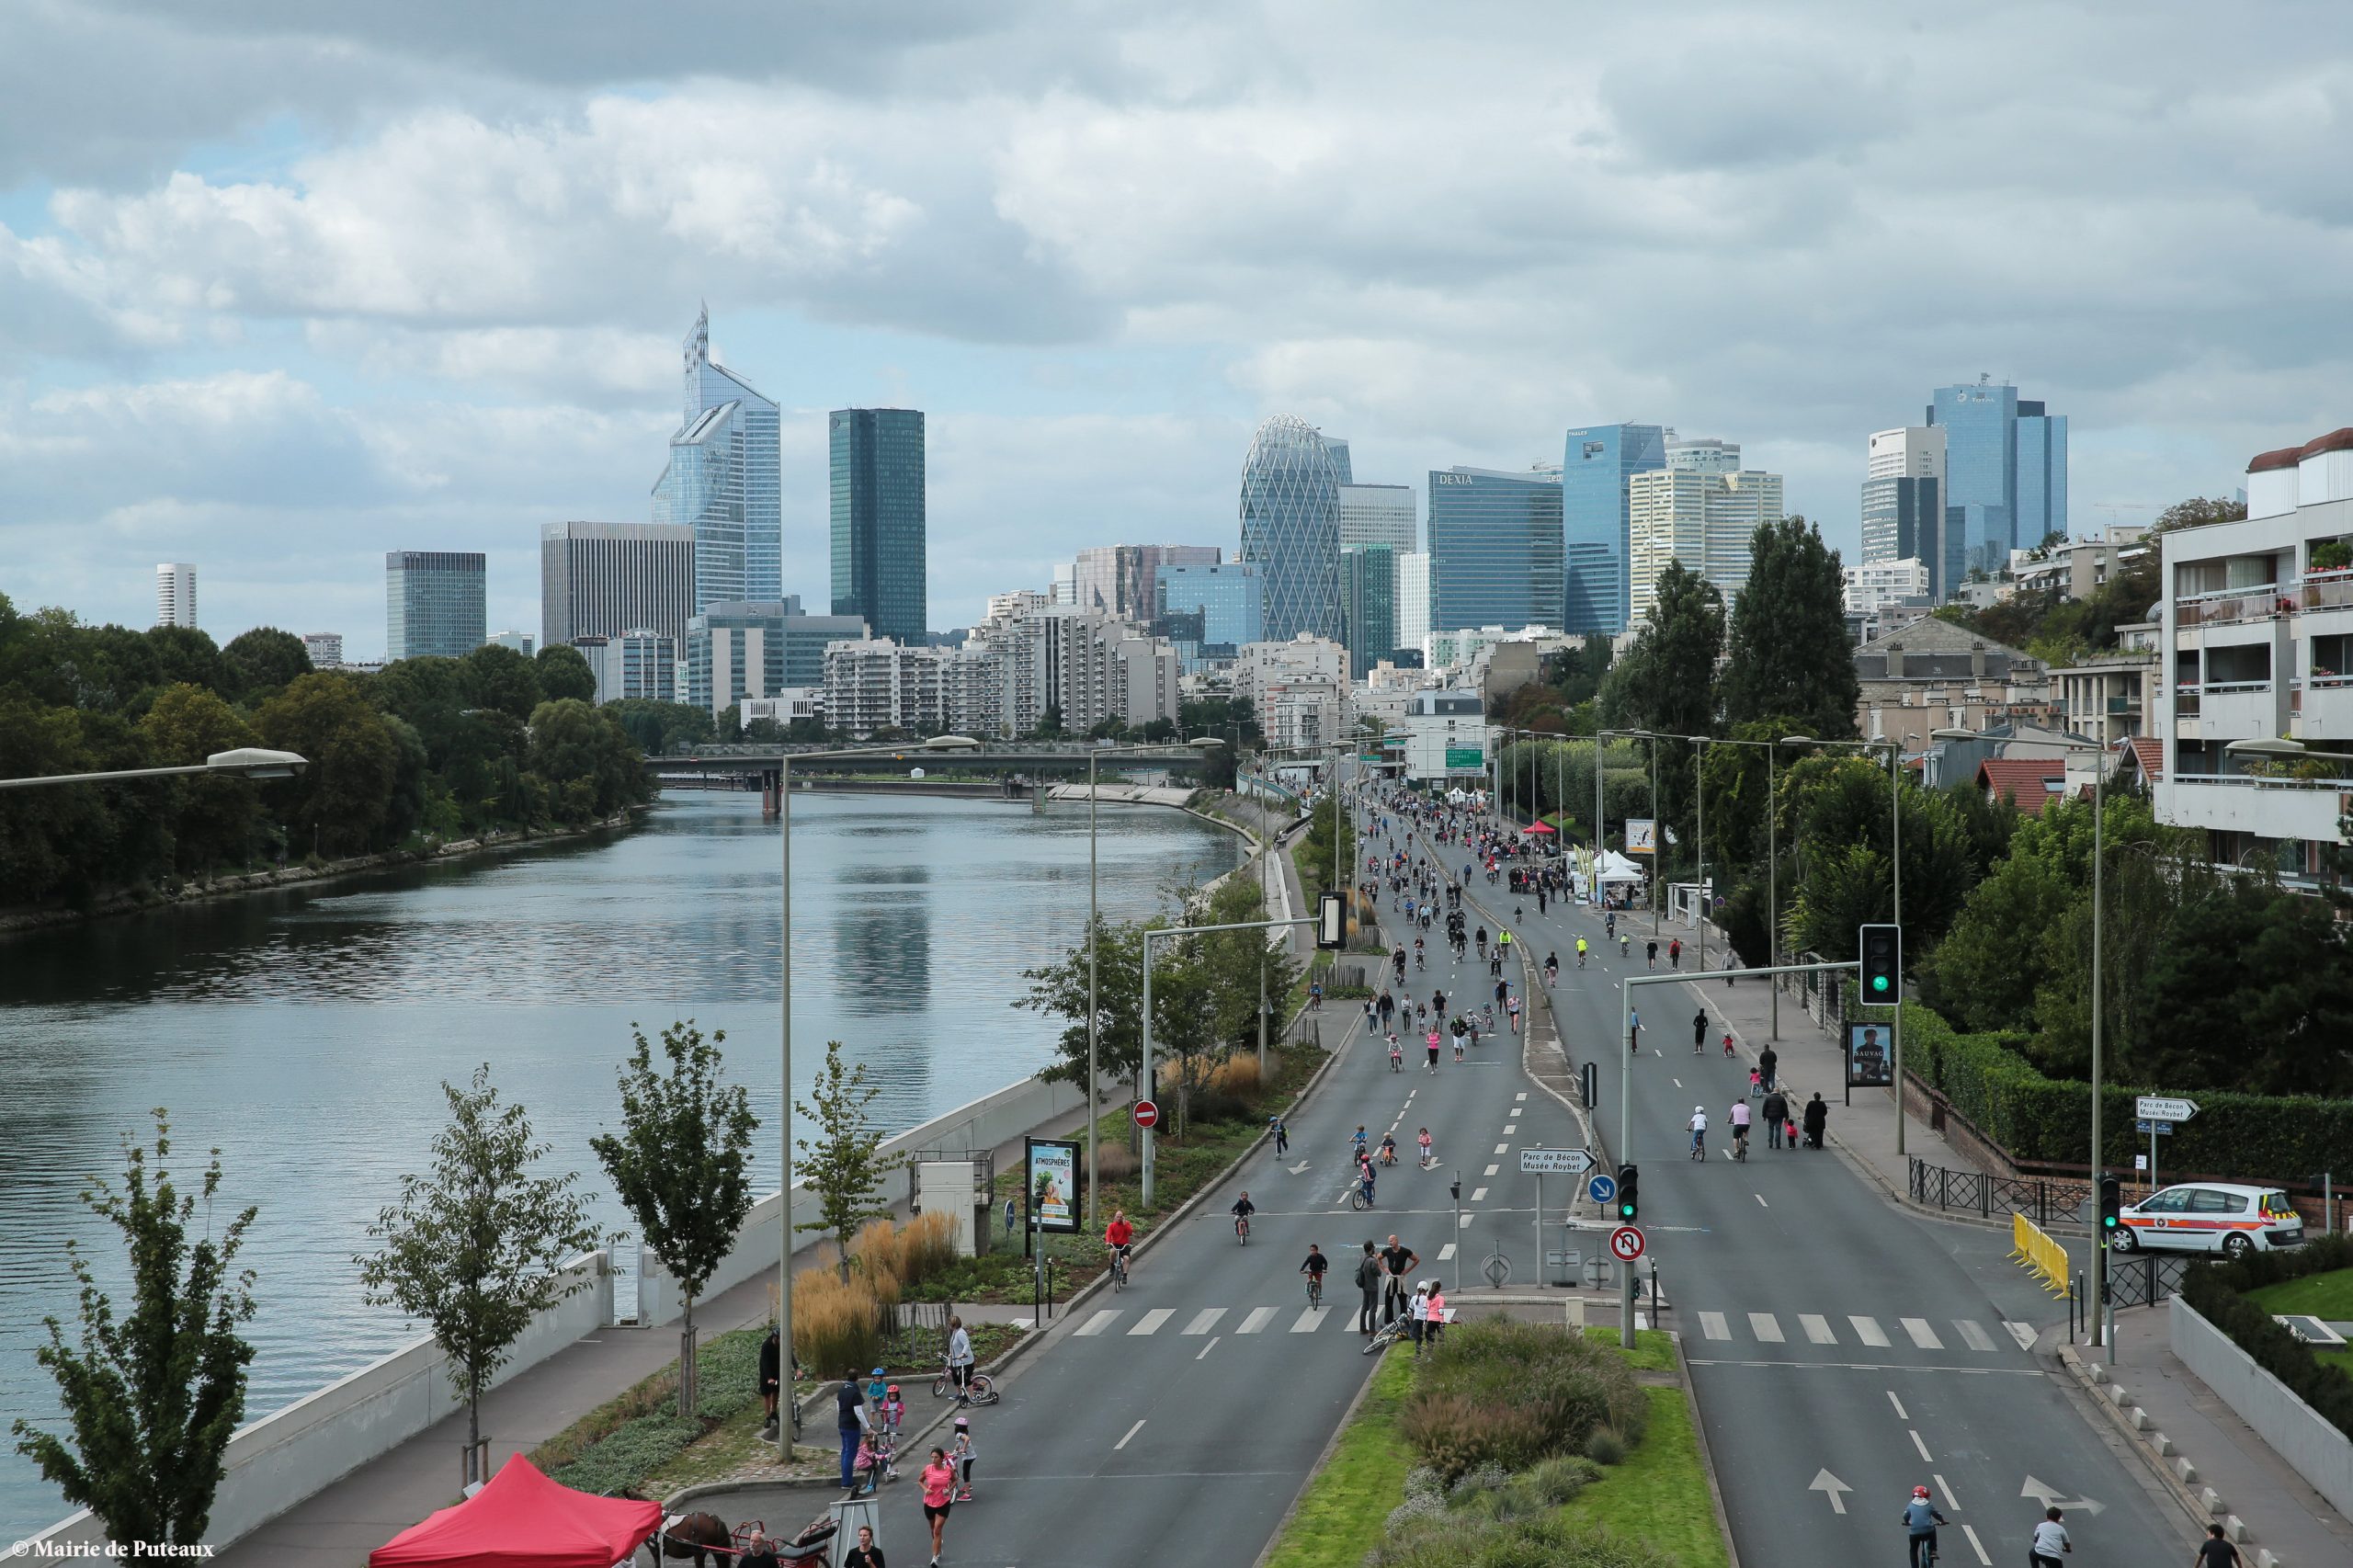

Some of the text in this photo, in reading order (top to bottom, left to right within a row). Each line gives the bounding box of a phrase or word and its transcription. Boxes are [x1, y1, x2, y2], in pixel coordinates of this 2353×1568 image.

[1439, 474, 1472, 485] DEXIA
[2161, 1109, 2183, 1118] Roybet
[1035, 1156, 1070, 1167] ATMOSPHÈRES
[1523, 1153, 1540, 1161] Parc
[1552, 1163, 1580, 1171] Roybet
